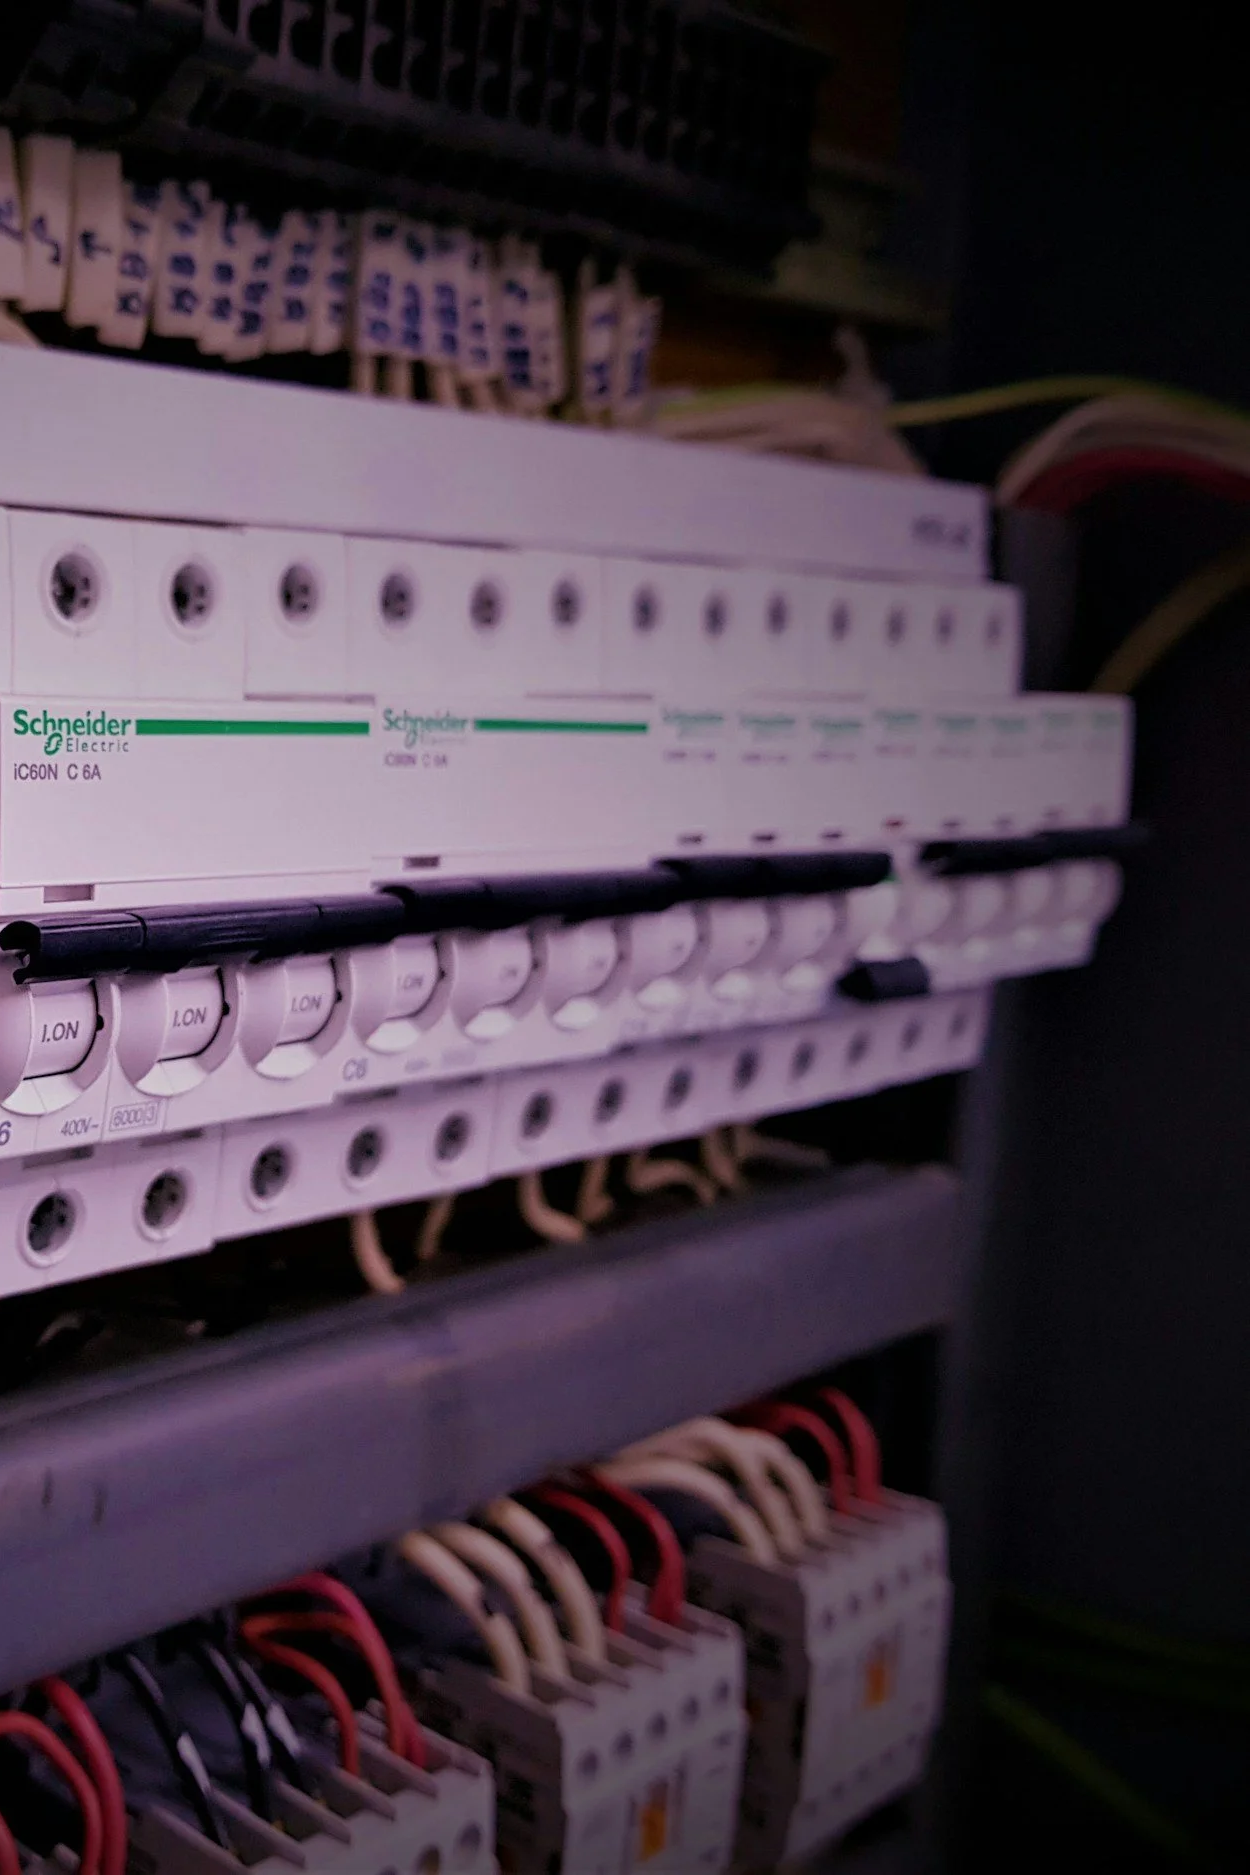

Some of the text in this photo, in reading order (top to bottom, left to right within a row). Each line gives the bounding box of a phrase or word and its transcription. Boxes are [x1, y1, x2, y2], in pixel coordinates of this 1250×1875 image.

[13, 709, 132, 736] Schneider
[383, 708, 468, 732] Schneider
[66, 737, 129, 752] Electric
[14, 763, 102, 780] iC60N C 6A
[172, 1007, 208, 1028] I.ON
[41, 1020, 80, 1043] I.ON
